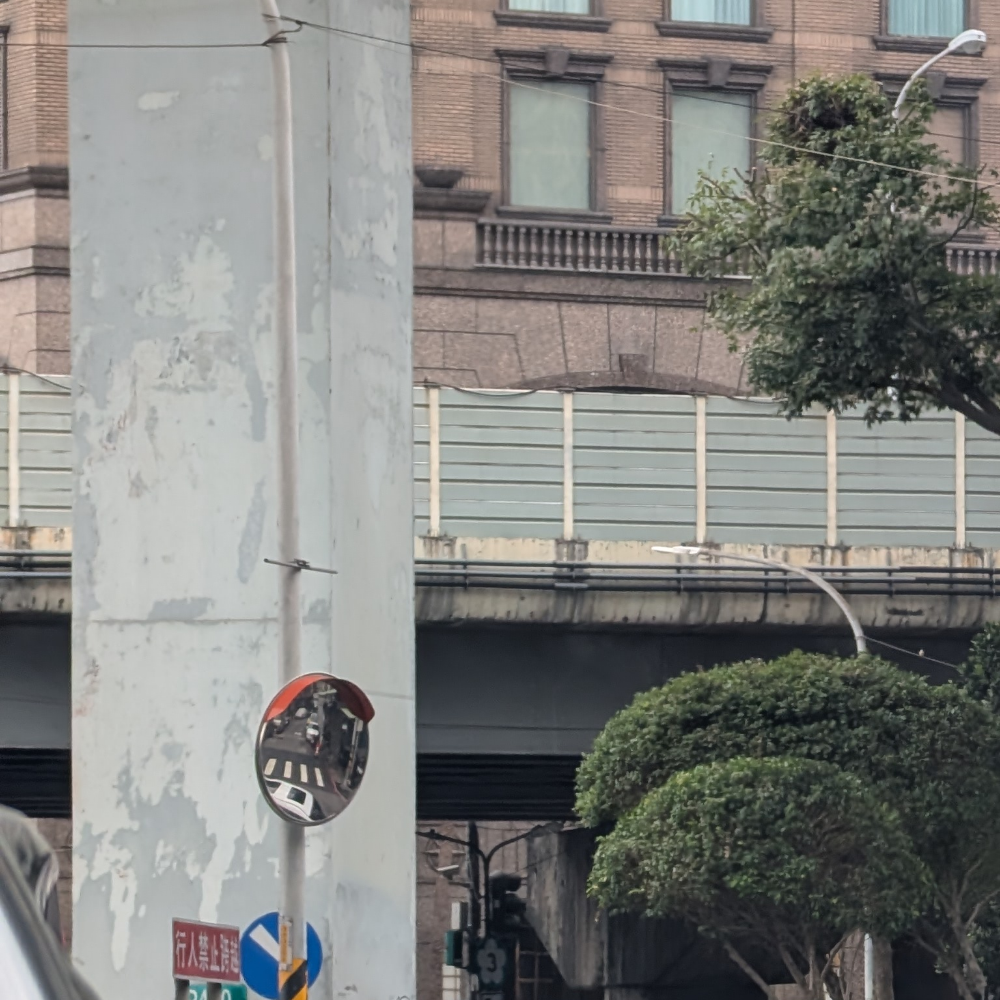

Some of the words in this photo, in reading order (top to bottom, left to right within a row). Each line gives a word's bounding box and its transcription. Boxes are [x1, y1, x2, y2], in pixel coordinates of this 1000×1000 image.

[176, 930, 240, 974] 行人禁止跨越
[487, 952, 497, 972] 3
